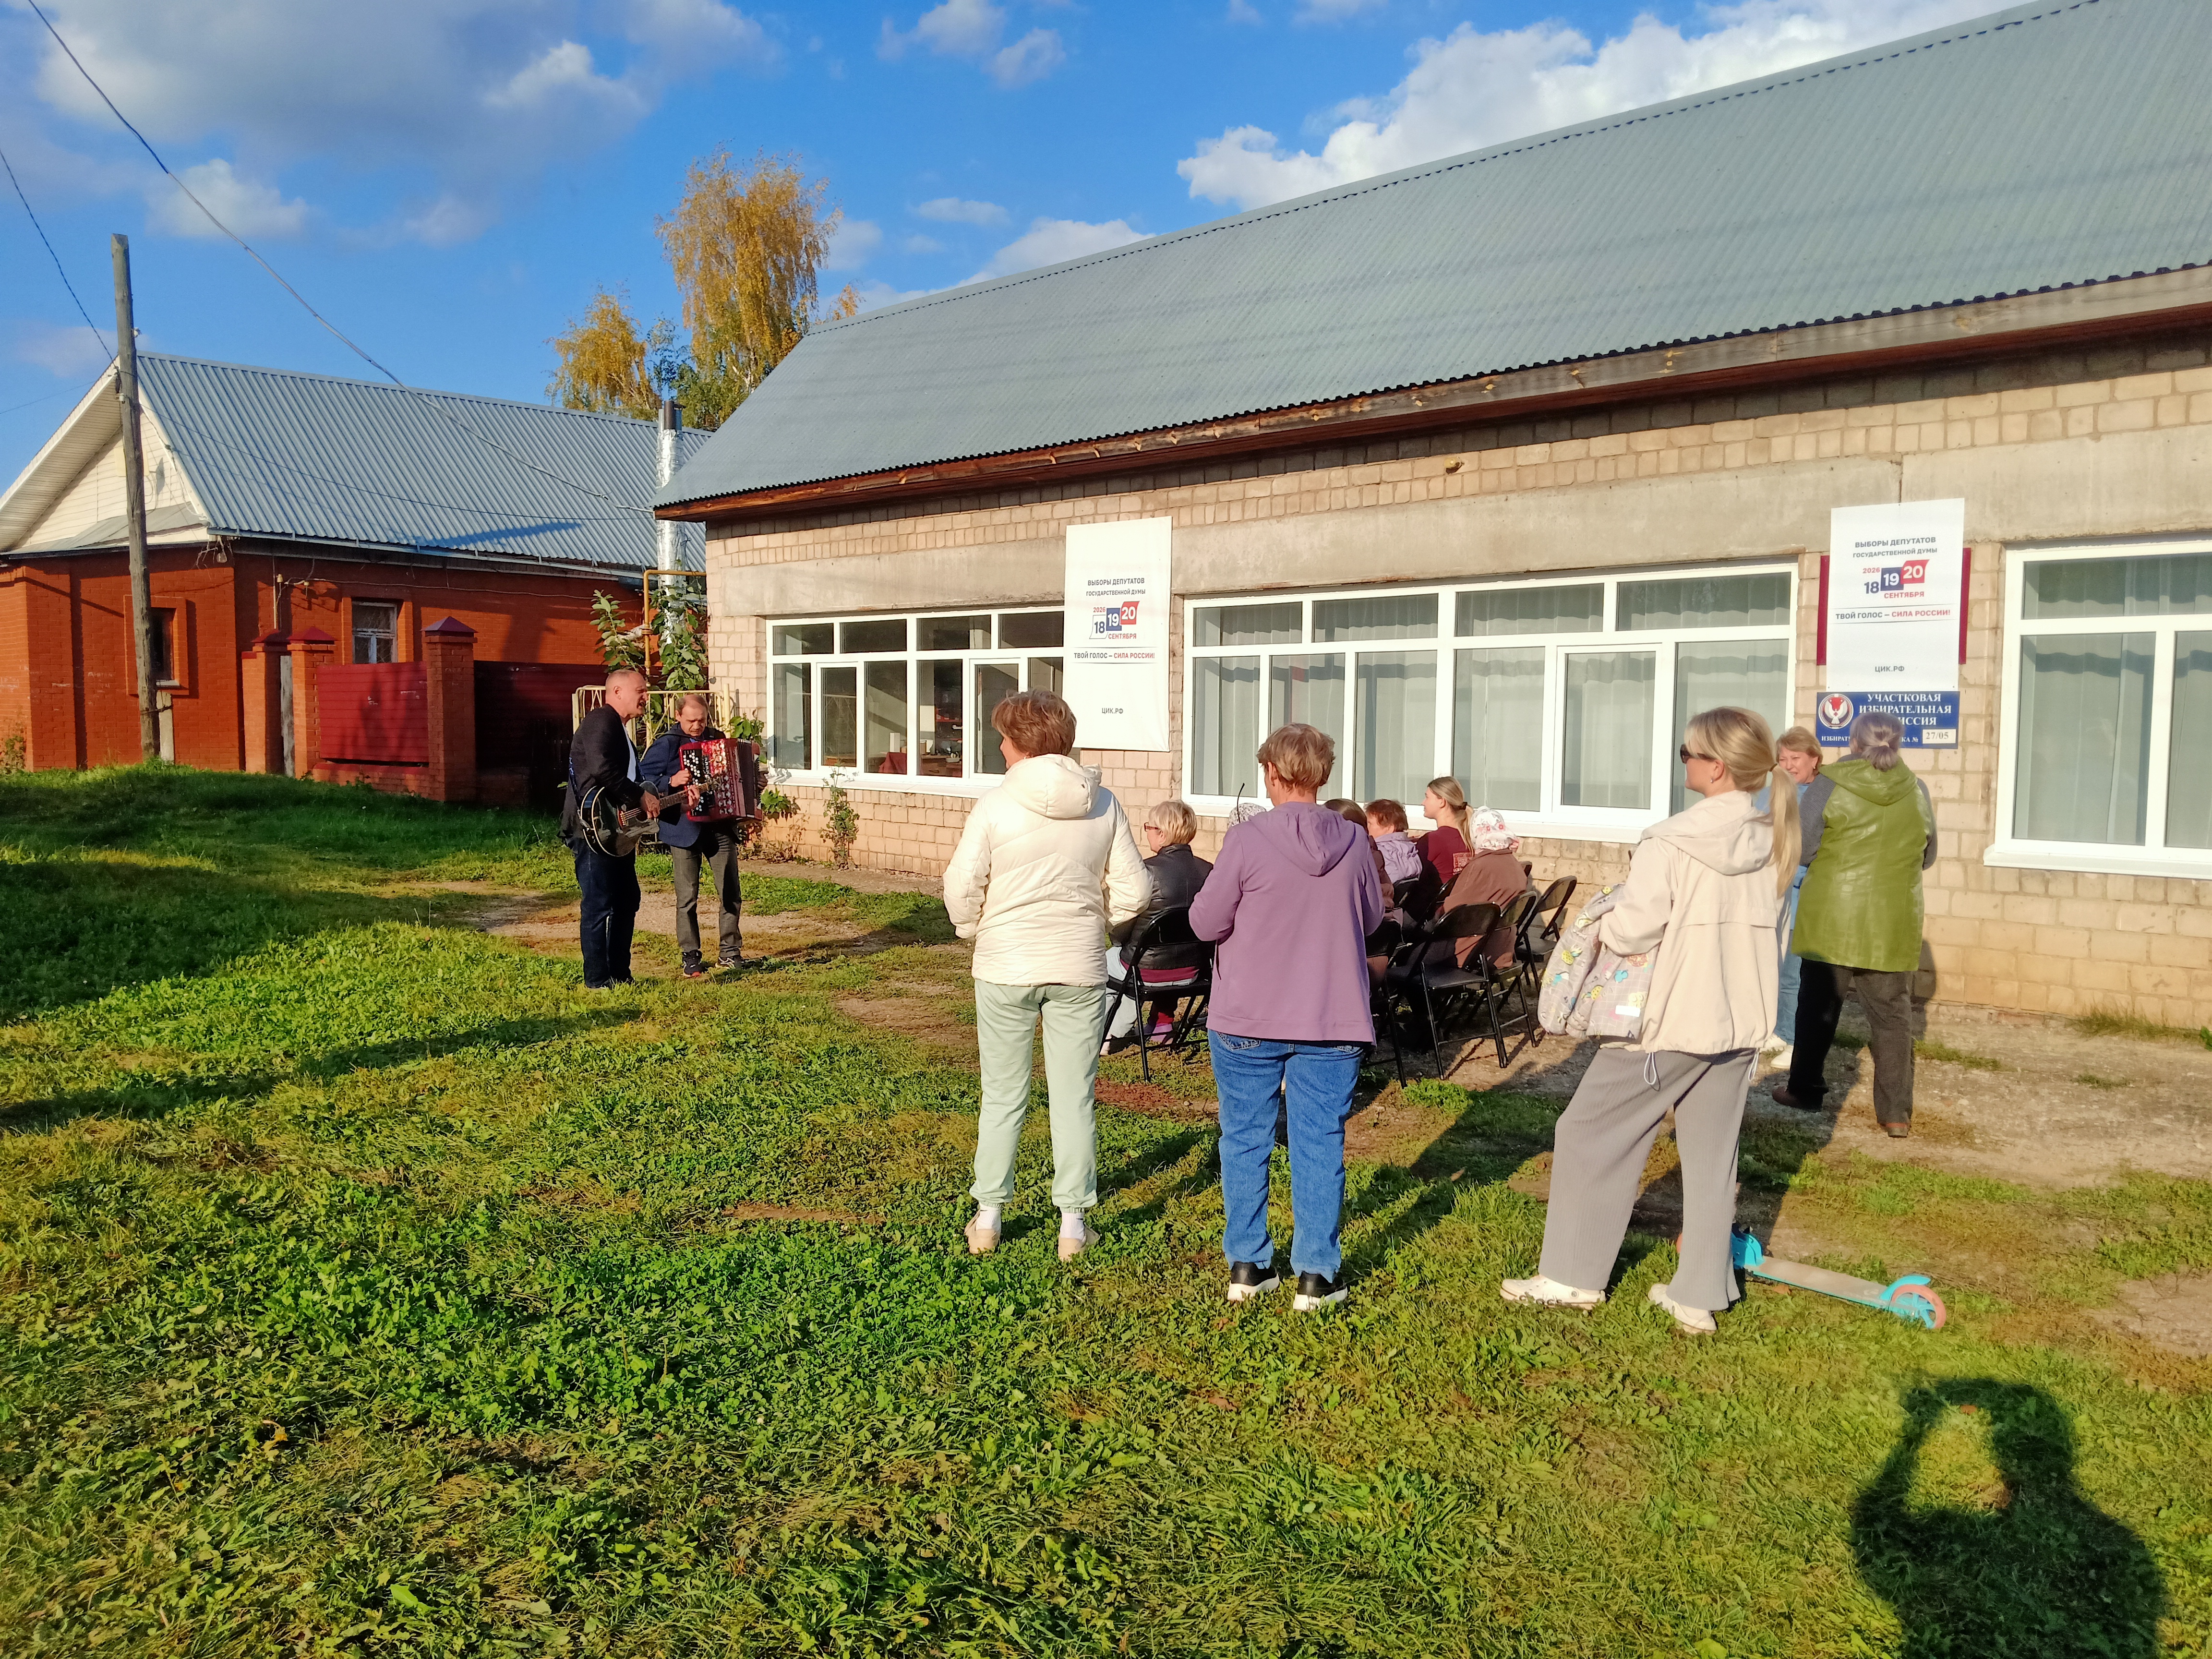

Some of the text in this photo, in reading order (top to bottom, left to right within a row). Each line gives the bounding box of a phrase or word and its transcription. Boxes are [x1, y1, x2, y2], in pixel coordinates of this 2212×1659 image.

[1855, 537, 1936, 548] ВЫБОРЫ ДЕПУТАТОВ
[1853, 548, 1915, 558] ГОСУДАРСТВЕННОЙ
[1112, 577, 1144, 586] ДЕПУТАТОВ
[1864, 565, 1923, 594] 18 19 20
[1094, 606, 1136, 634] 18 19 20
[1867, 694, 1941, 702] УЧАСТКОВАЯ
[1859, 705, 1952, 714] ИЗБИРАТЕЛЬНАЯ
[1926, 732, 1949, 740] 27/05
